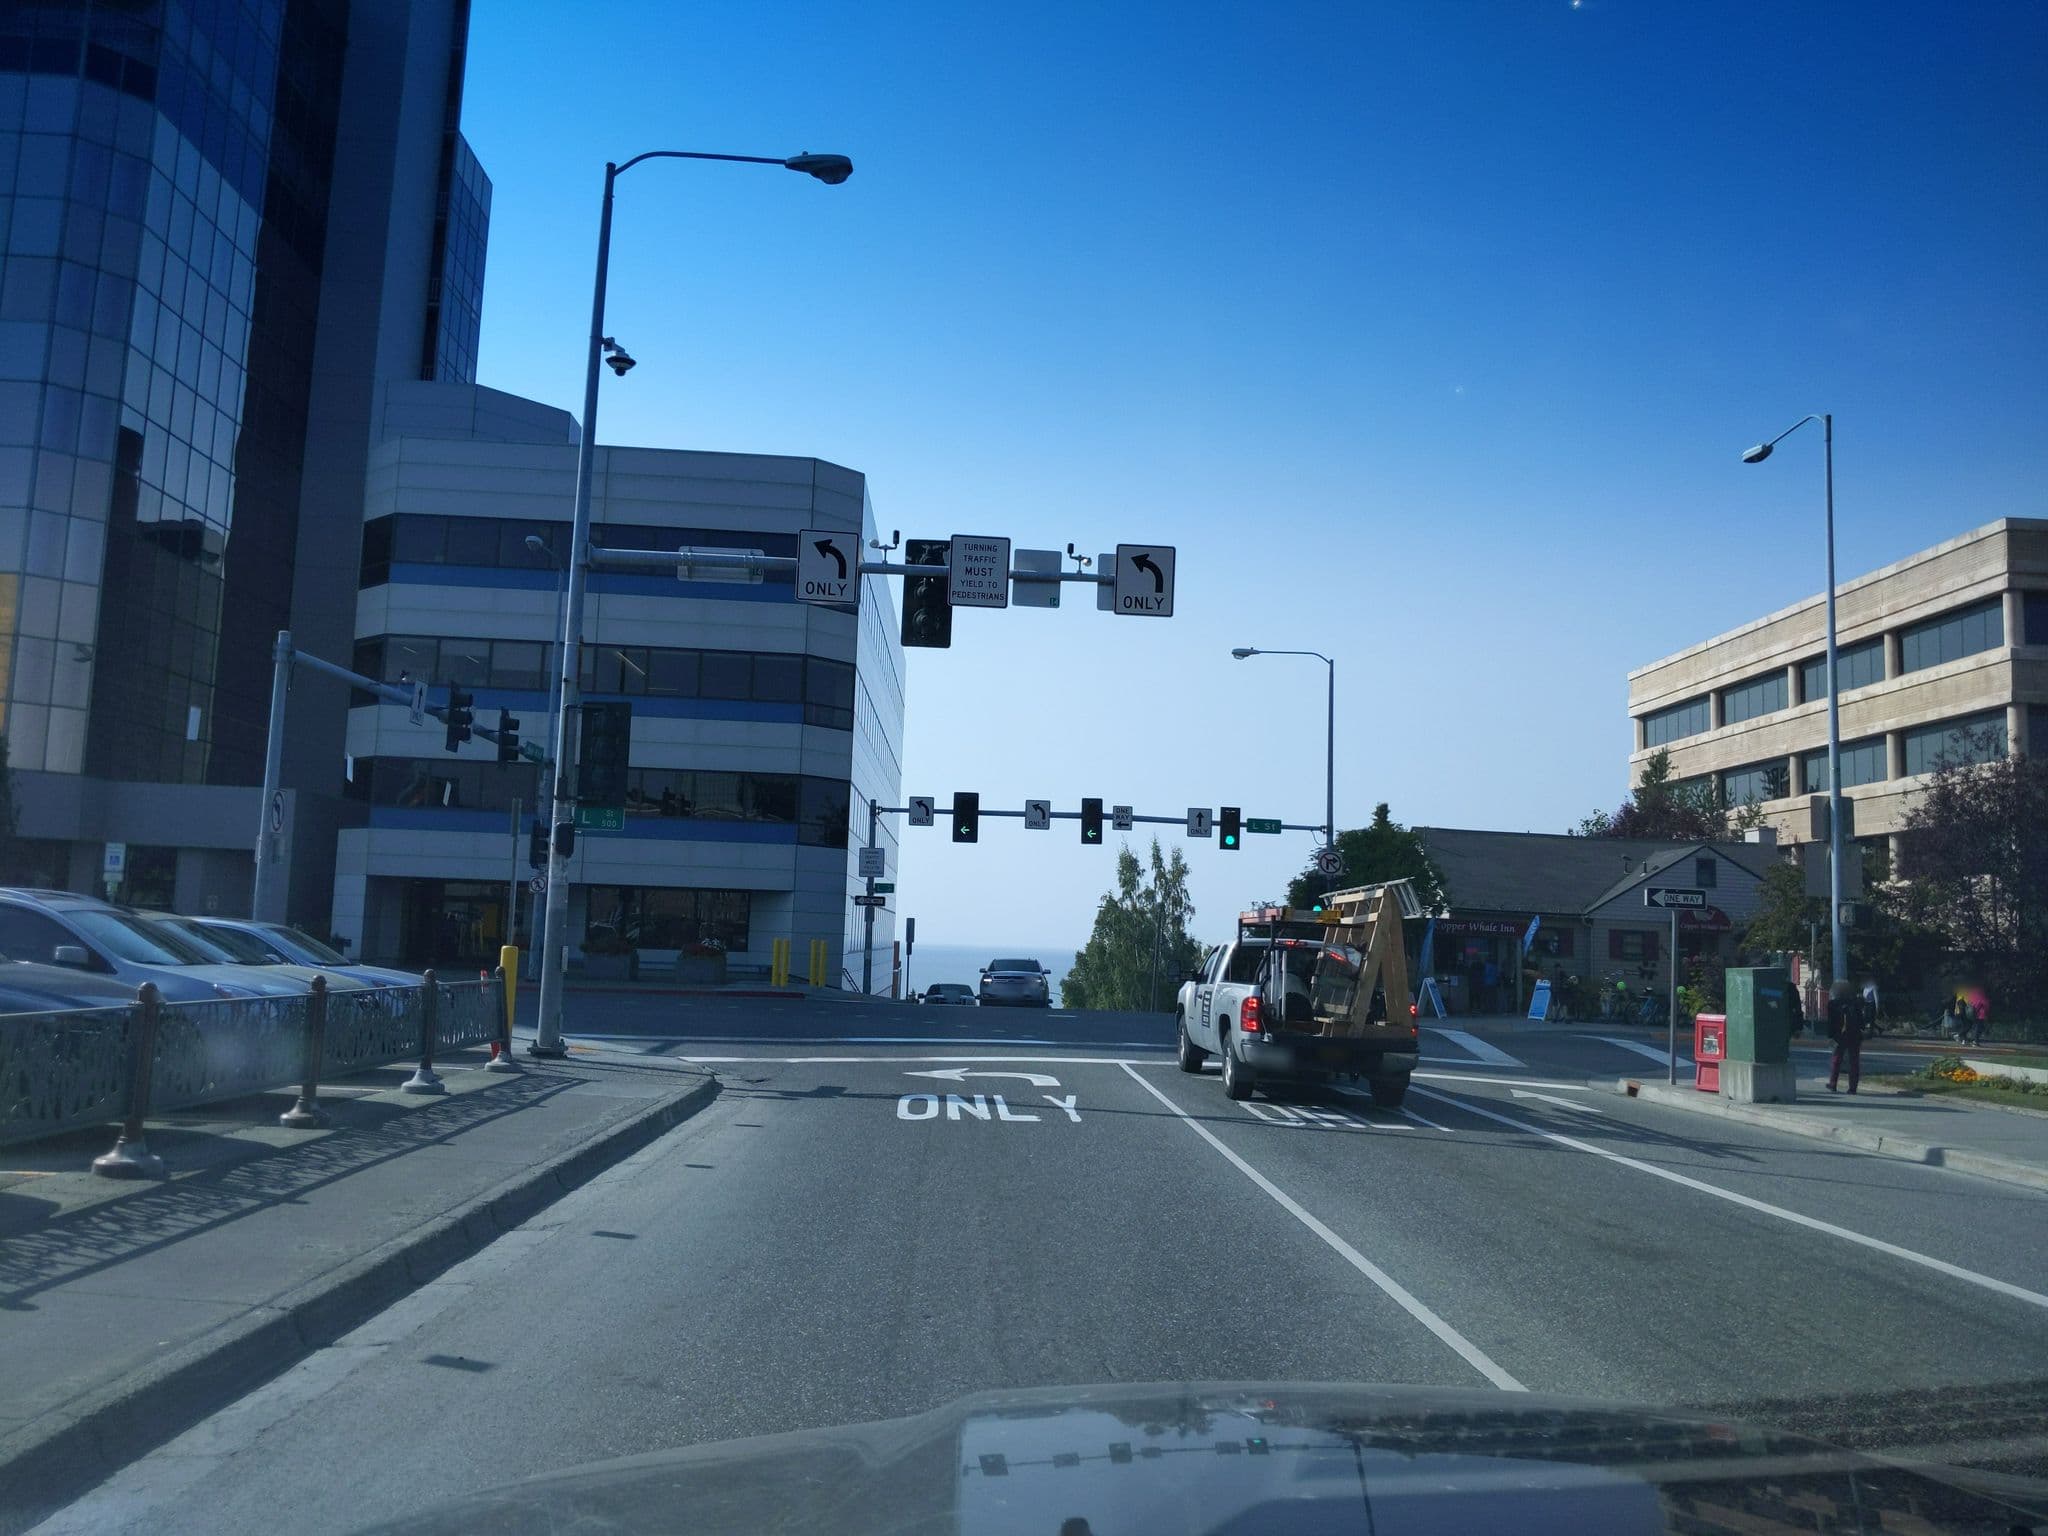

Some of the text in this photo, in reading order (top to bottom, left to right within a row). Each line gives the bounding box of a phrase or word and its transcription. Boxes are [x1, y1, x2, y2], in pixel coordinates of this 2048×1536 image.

[964, 543, 998, 552] TURNING
[963, 554, 997, 564] TRAFFIC
[965, 566, 993, 577] MUST
[805, 581, 848, 597] ONLY
[960, 579, 998, 589] YIELD TO
[951, 590, 1005, 601] PEDESTRIANS
[1123, 595, 1164, 610] ONLY
[582, 810, 592, 824] L
[1252, 822, 1259, 830] L
[1664, 894, 1700, 904] ONE WAY
[1469, 920, 1497, 932] Whale
[1500, 923, 1515, 933] Inn
[896, 1093, 1082, 1123] ONLY
